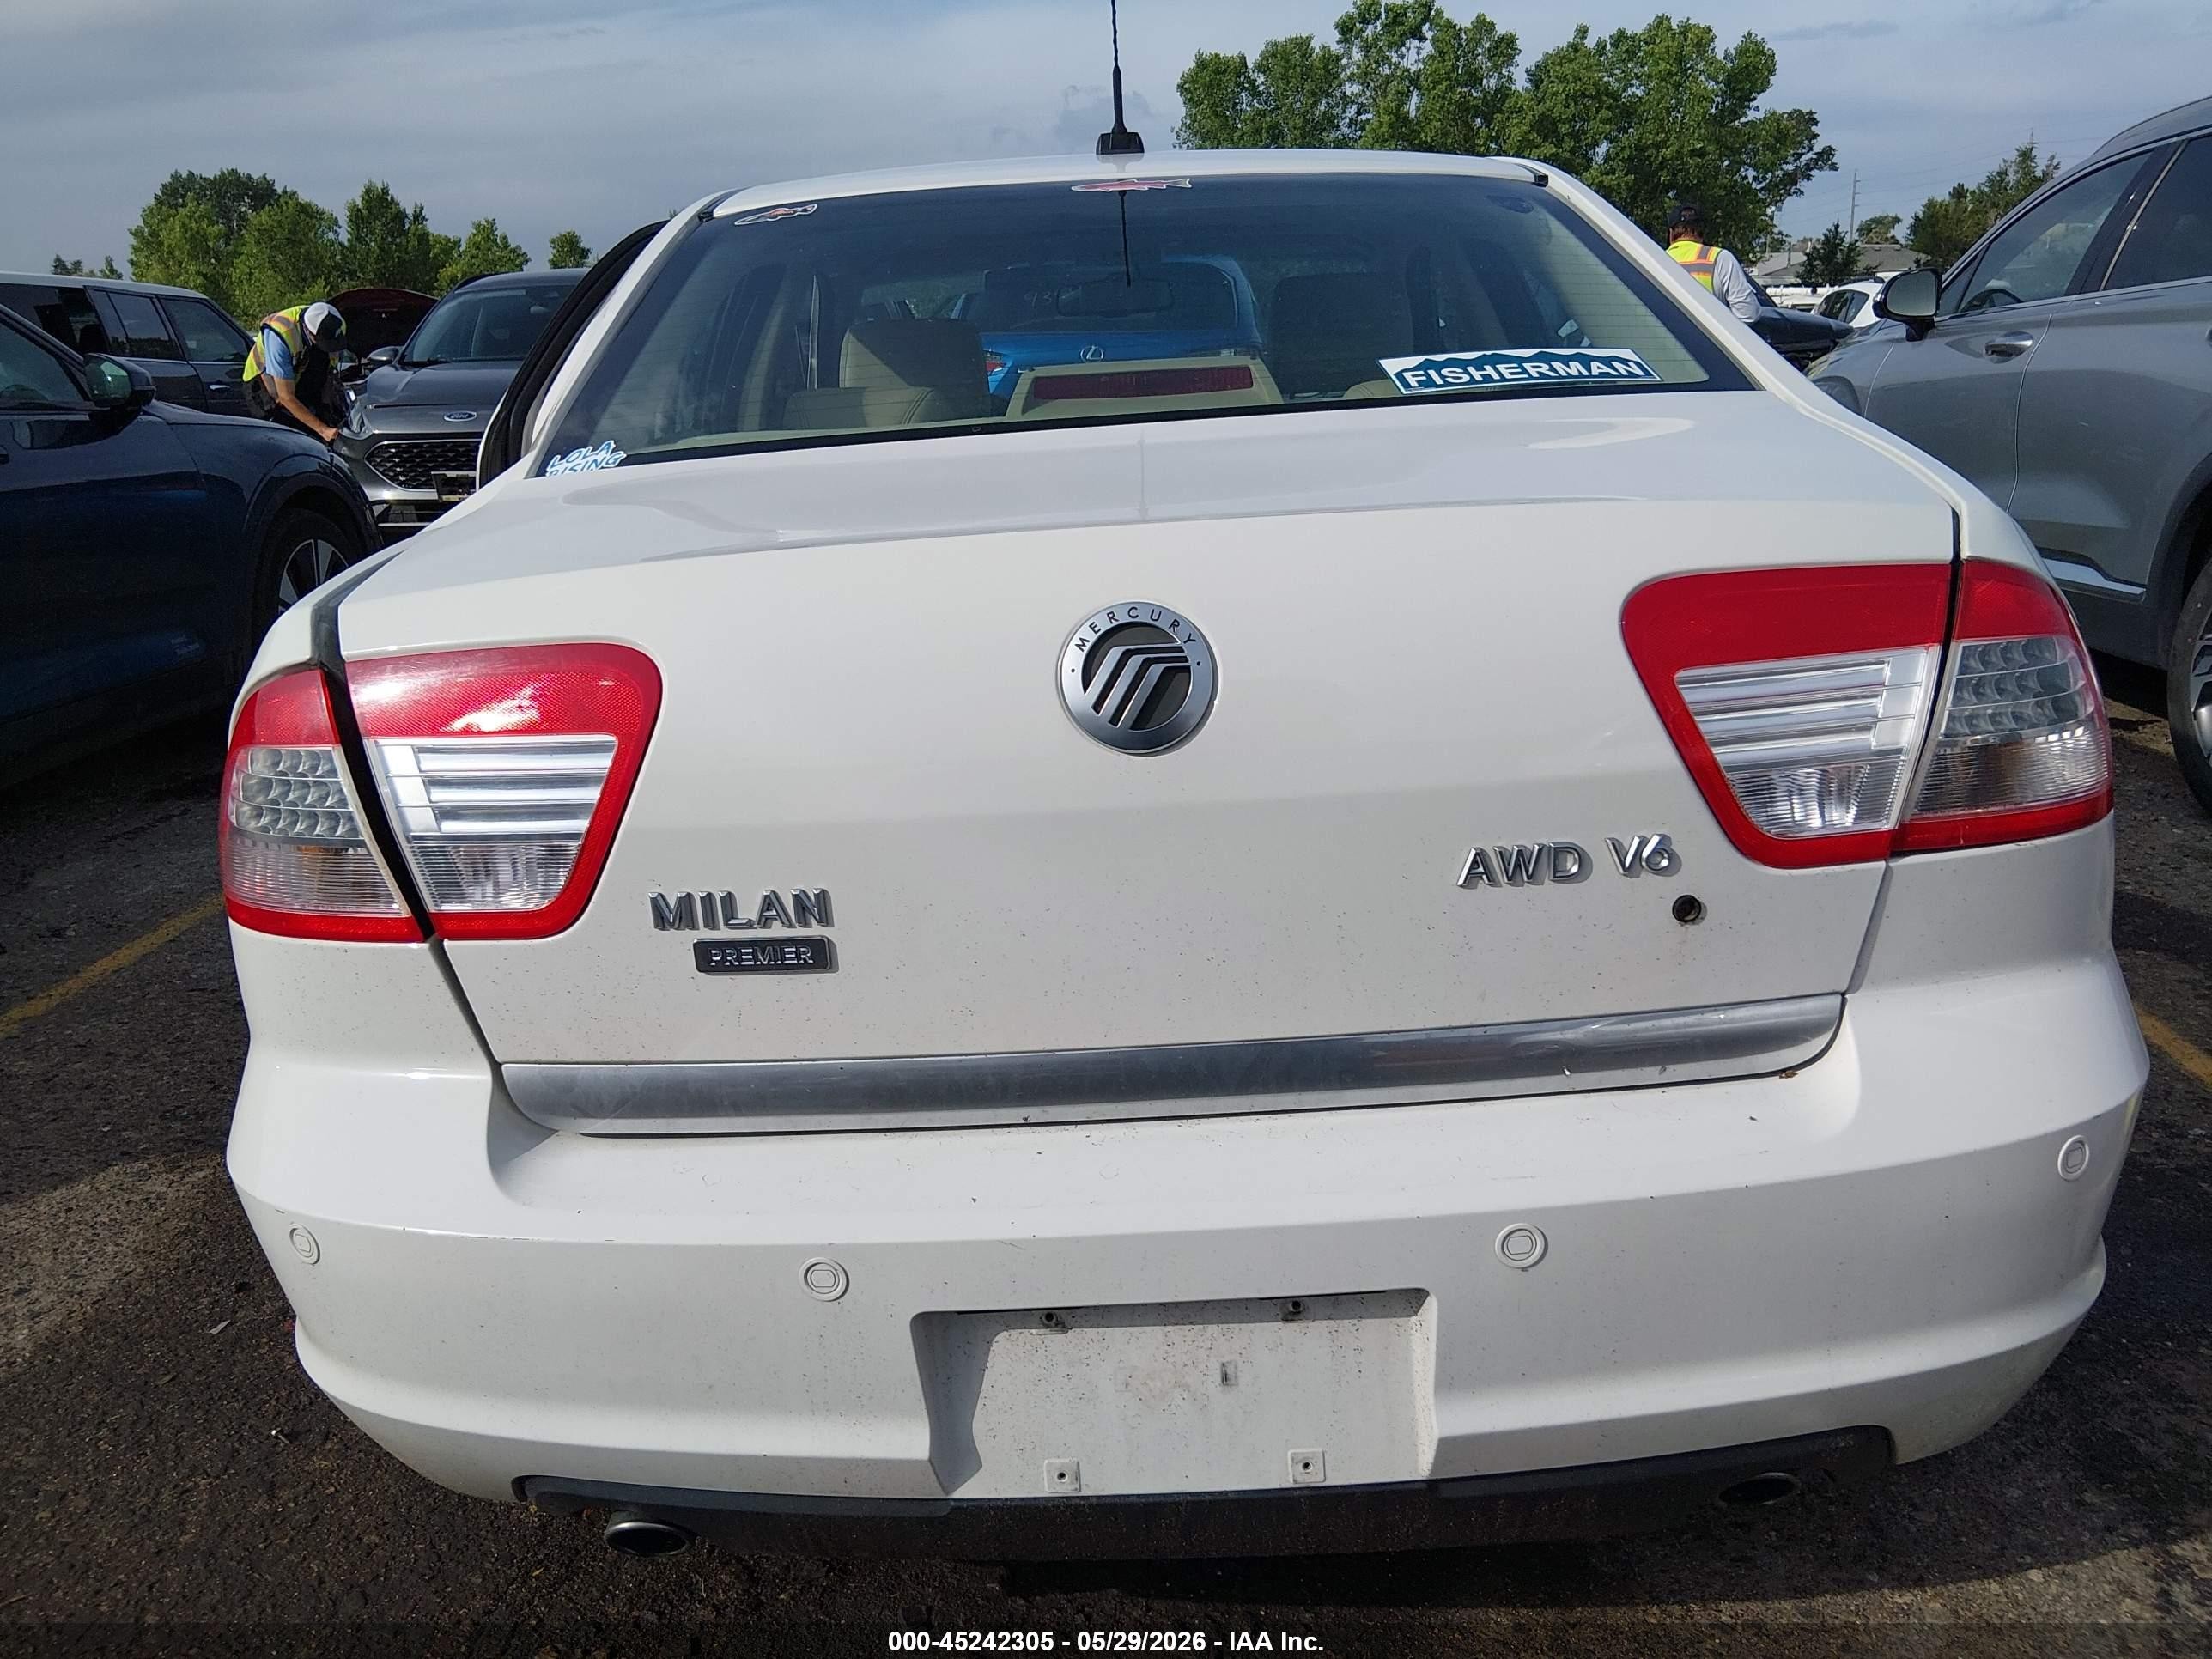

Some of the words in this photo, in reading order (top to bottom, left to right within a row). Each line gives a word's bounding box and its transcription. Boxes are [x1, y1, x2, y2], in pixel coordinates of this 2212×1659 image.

[1401, 359, 1645, 387] FISHERMAN
[549, 441, 615, 469] LOLA
[1074, 606, 1196, 652] MERCURY
[1457, 842, 1581, 886] AWD
[1605, 833, 1673, 875] V6
[648, 888, 833, 930] MILAN
[709, 945, 814, 966] PREMIER
